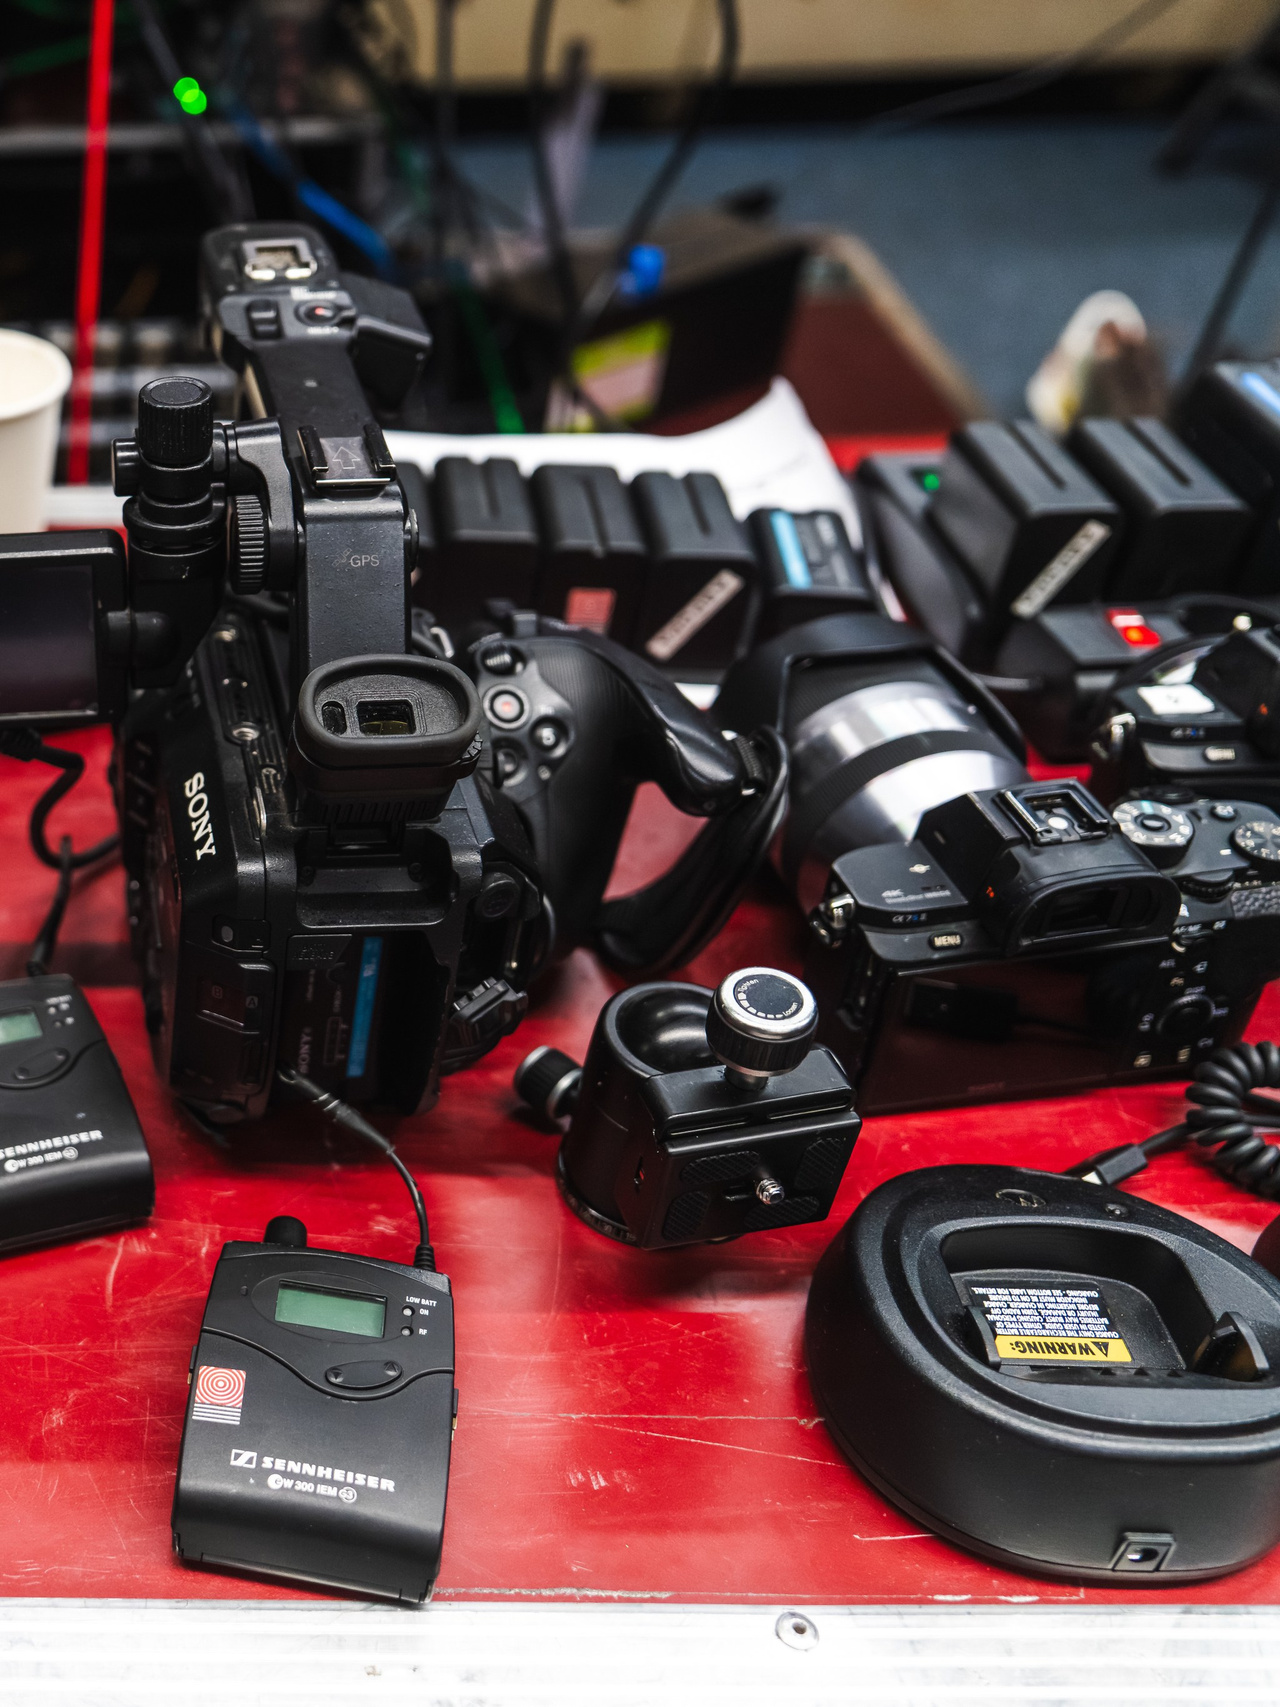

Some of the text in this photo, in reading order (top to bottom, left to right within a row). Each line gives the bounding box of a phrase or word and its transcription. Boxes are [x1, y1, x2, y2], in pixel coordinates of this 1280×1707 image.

[350, 554, 380, 567] GPS
[184, 772, 217, 861] SONY
[27, 1154, 44, 1166] 300
[44, 1150, 63, 1163] IEM
[996, 1287, 1011, 1295] FOR
[1026, 1288, 1052, 1296] BOTTOM
[1065, 1290, 1099, 1298] CHARGING
[405, 1295, 437, 1307] LOW BATT
[983, 1300, 1008, 1308] CHARGE
[1055, 1296, 1089, 1304] INDICATOR
[1044, 1302, 1078, 1310] INSERTING
[1075, 1303, 1100, 1311] BEFORE
[419, 1308, 429, 1316] ON
[1020, 1308, 1039, 1316] TURN
[1064, 1316, 1080, 1324] MAY
[1079, 1317, 1110, 1325] BATTERIES
[1062, 1323, 1080, 1331] USER
[1086, 1324, 1108, 1332] LISTED
[418, 1328, 428, 1336] RF
[1077, 1330, 1096, 1338] ONLY
[1094, 1331, 1119, 1339] CHARGE
[1009, 1340, 1096, 1356] WARNING:
[261, 1456, 396, 1493] SENNHEISER
[294, 1480, 315, 1493] 300
[316, 1484, 338, 1498] IEM
